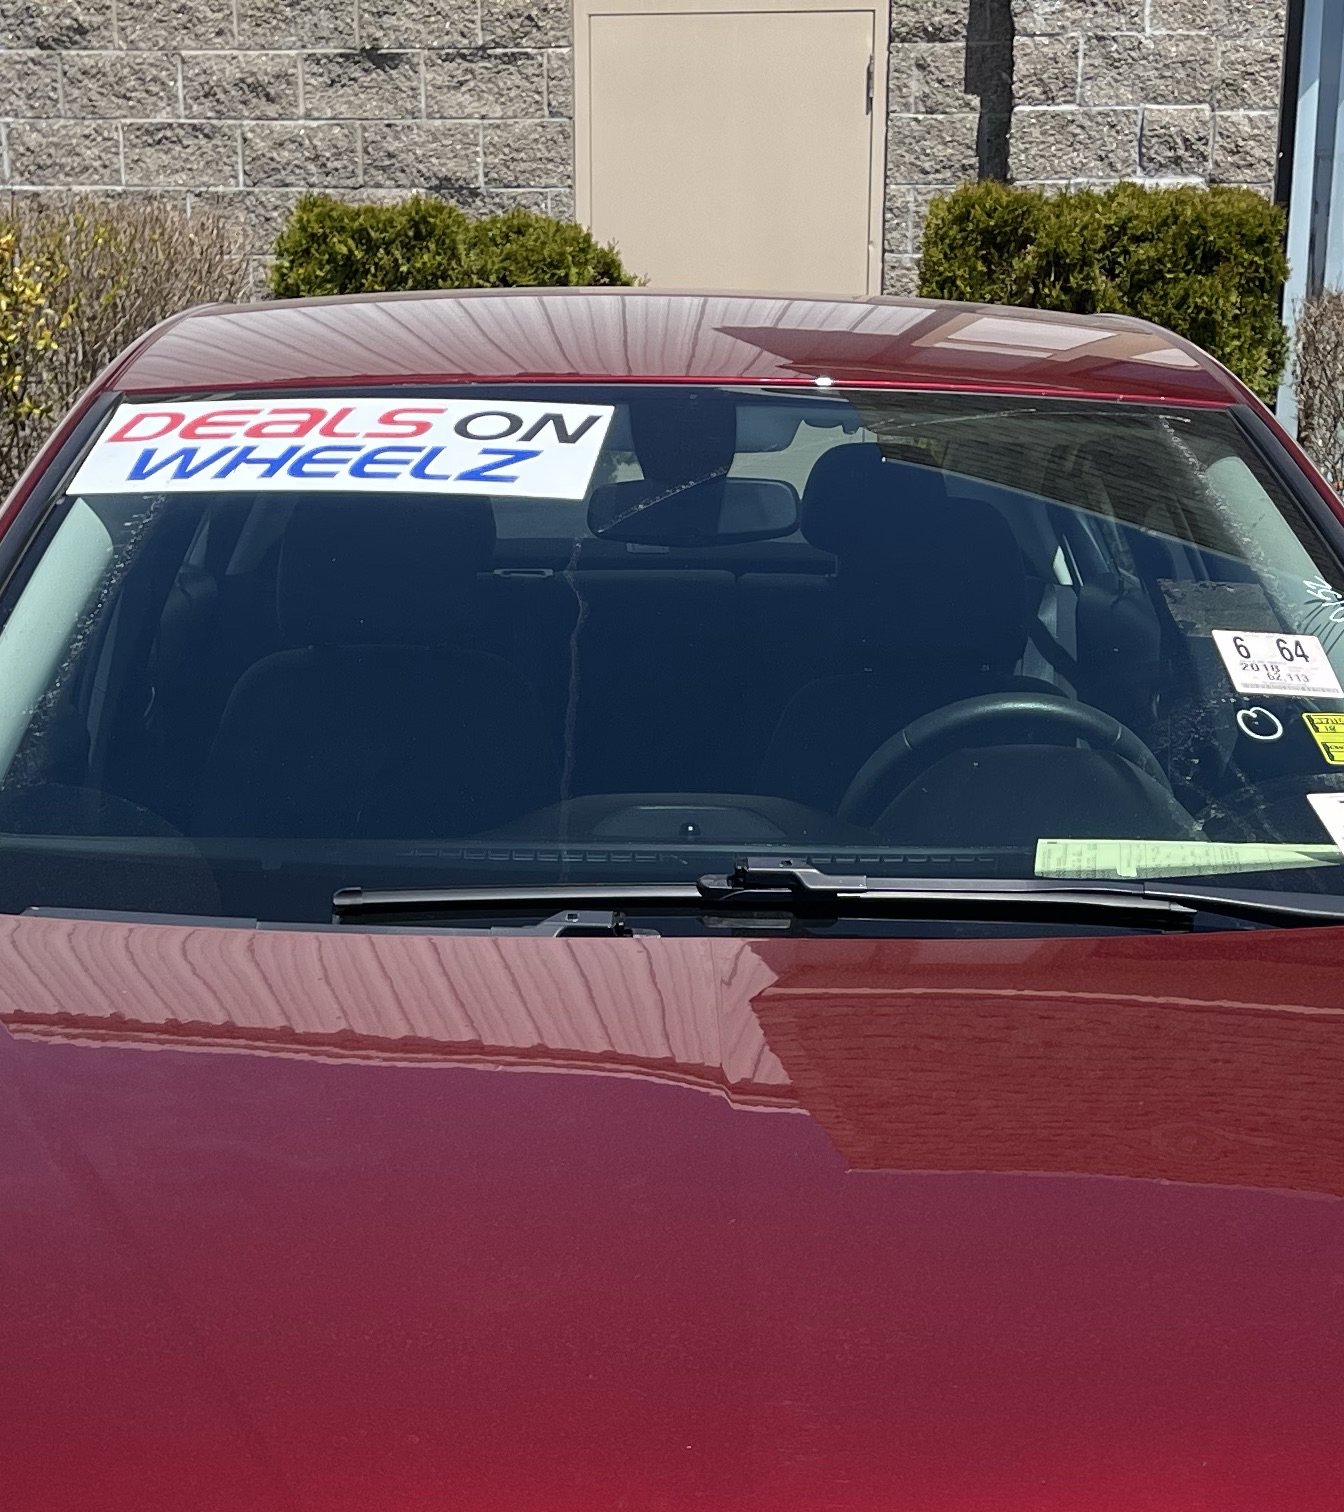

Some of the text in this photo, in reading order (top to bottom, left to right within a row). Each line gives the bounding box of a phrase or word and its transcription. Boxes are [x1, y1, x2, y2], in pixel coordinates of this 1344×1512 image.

[453, 411, 603, 445] ON
[126, 444, 545, 484] WHEELZ
[1233, 636, 1311, 663] 6 64
